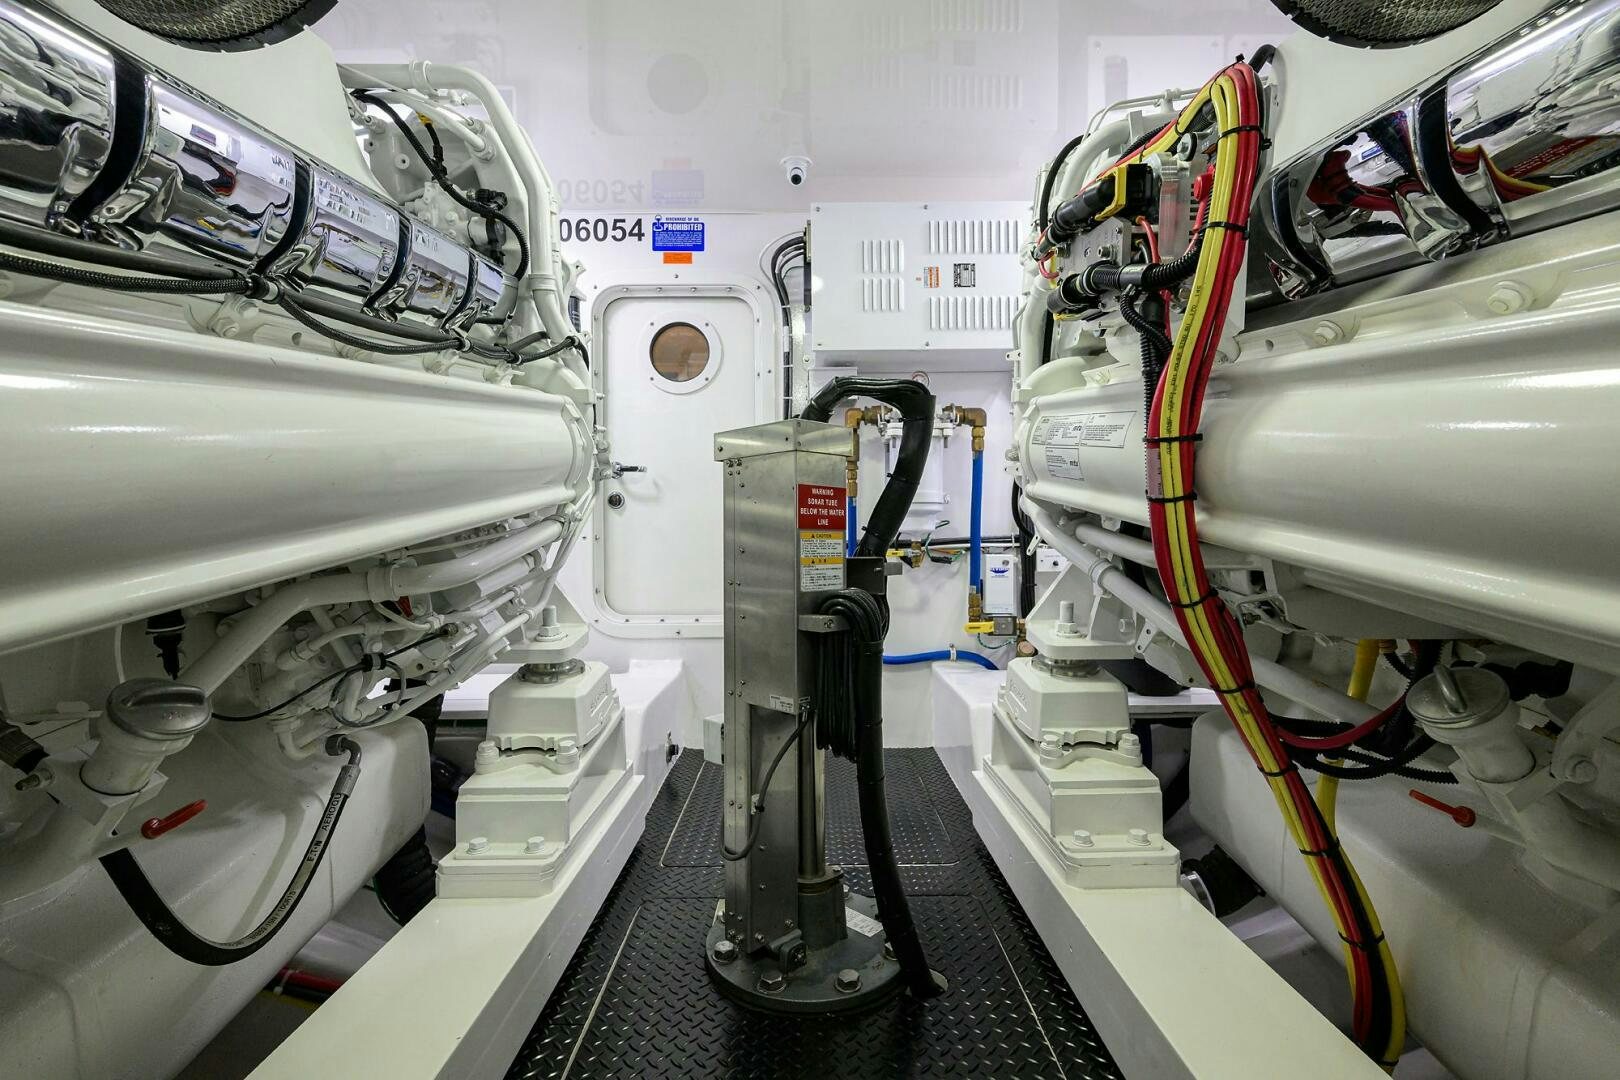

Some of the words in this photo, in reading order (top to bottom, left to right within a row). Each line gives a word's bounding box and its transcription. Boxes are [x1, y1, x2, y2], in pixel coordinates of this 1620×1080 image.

[559, 218, 645, 242] 06054
[663, 223, 703, 231] PROHIBITED
[811, 488, 834, 496] WARNING
[807, 497, 825, 506] SONAR
[825, 499, 838, 507] TUBE
[800, 507, 818, 515] BELOW
[818, 508, 829, 516] THE
[829, 509, 845, 517] WATER
[817, 518, 829, 526] LINE
